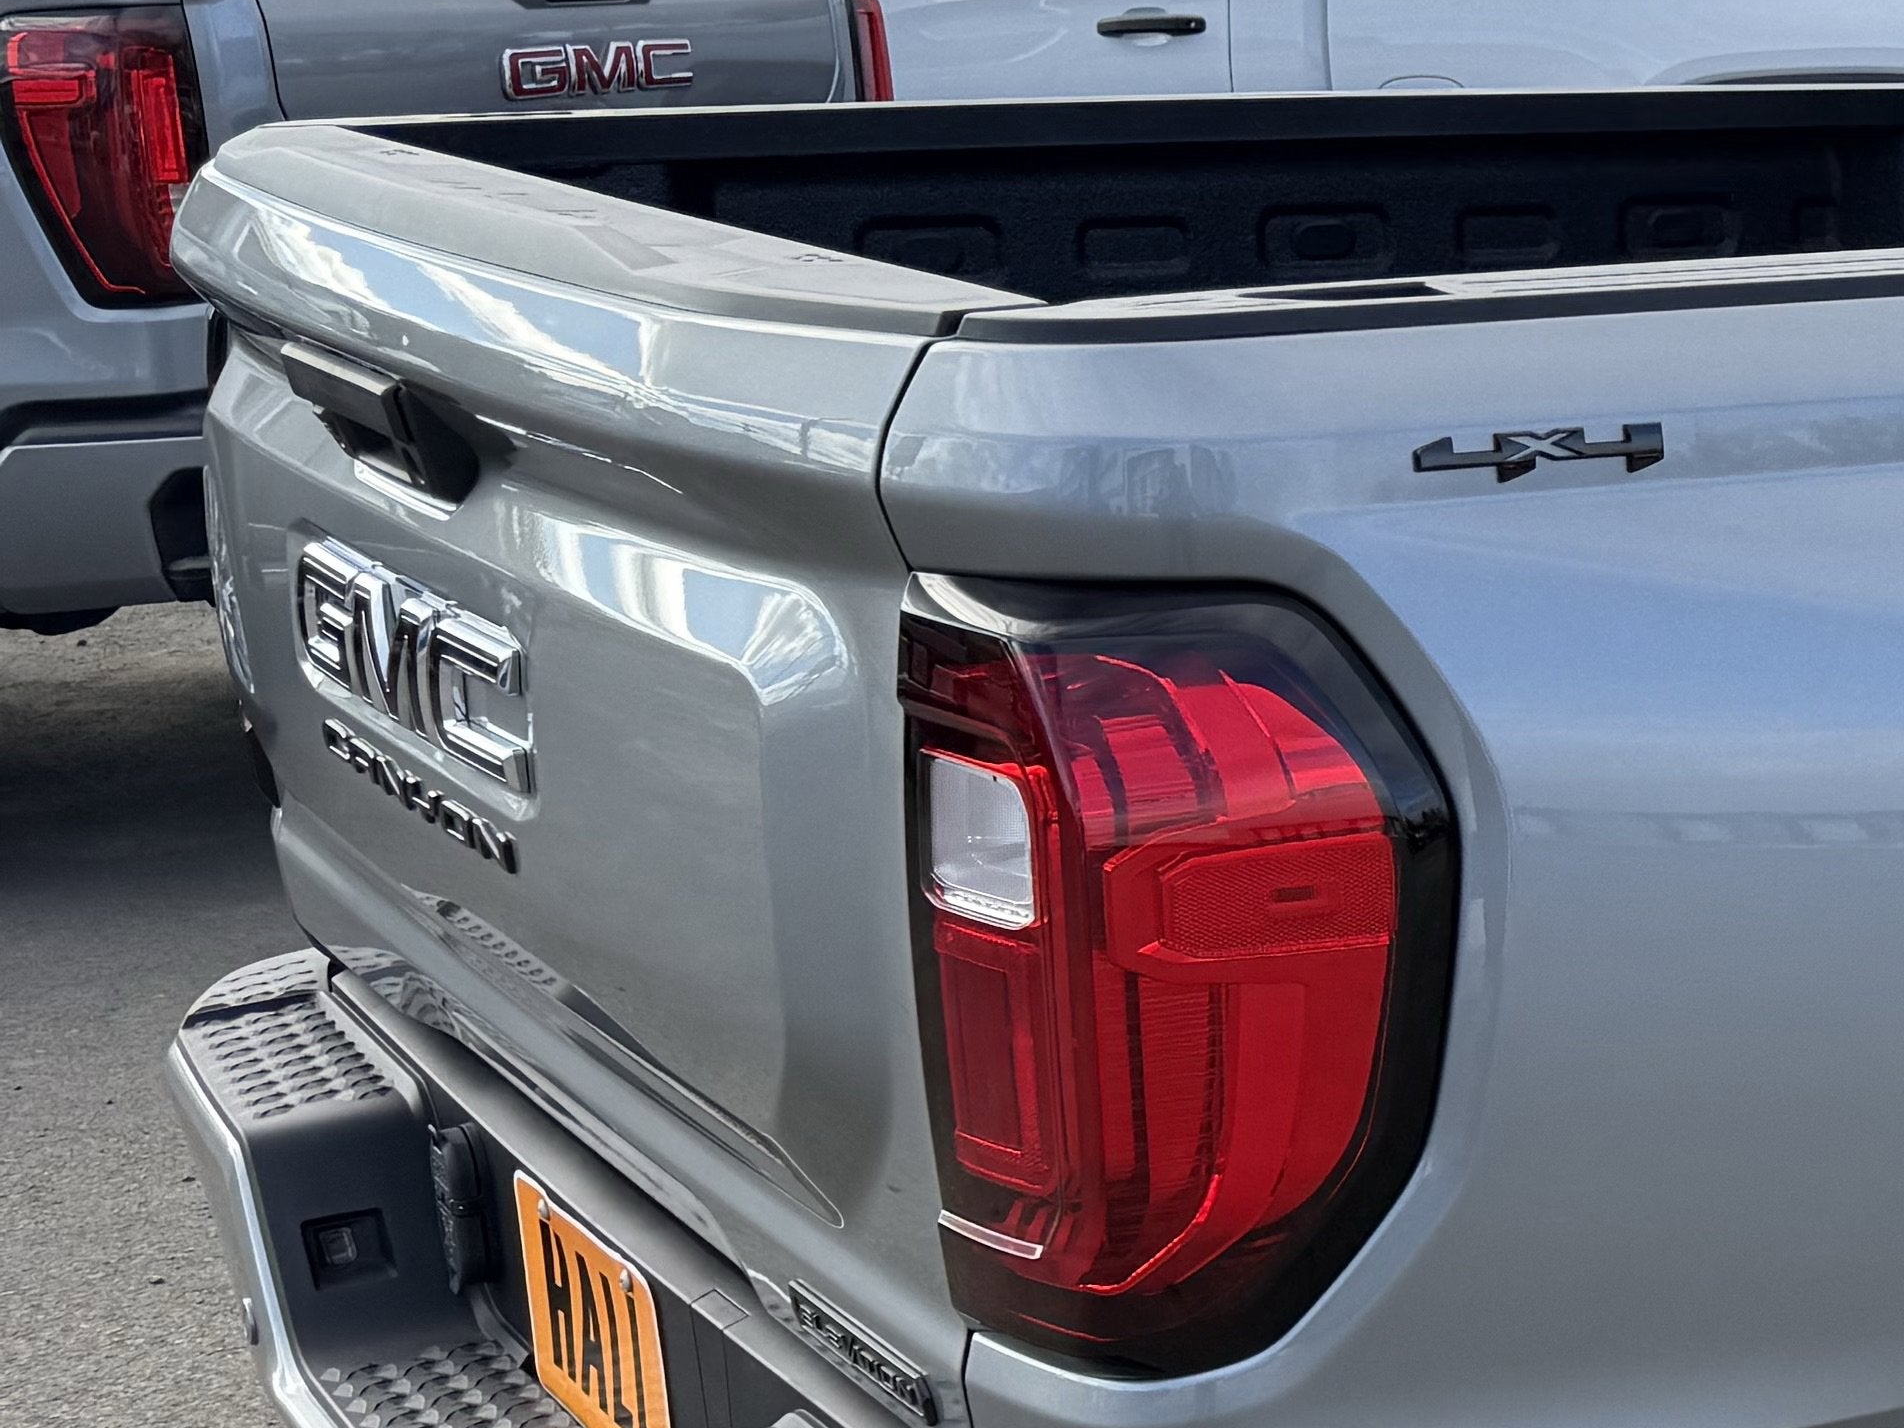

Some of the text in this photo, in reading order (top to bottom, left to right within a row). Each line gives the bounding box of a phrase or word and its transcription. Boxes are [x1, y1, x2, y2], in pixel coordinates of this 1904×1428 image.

[502, 37, 694, 101] GMC
[297, 536, 537, 795] GMC
[322, 717, 520, 875] CANYON
